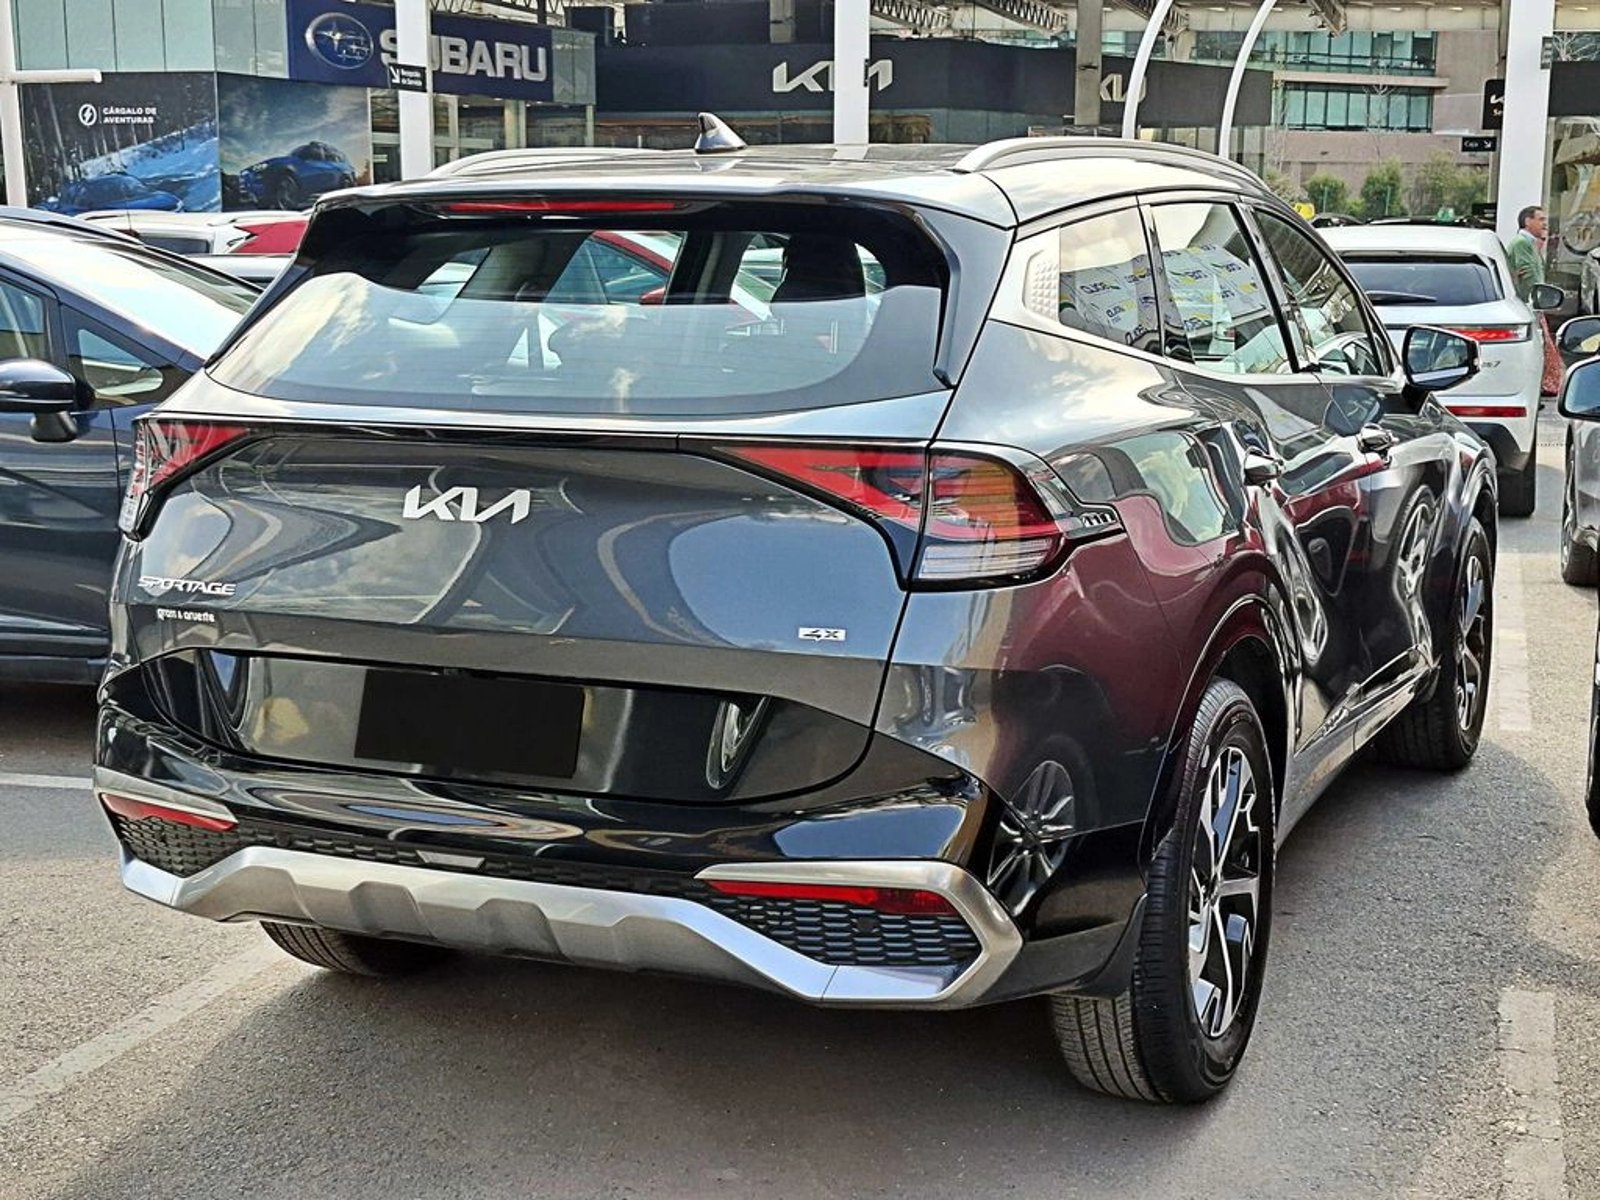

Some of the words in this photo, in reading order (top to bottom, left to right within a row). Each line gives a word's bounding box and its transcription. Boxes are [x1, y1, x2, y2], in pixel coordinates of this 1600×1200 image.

[102, 105, 143, 115] CÁRGALO
[144, 107, 157, 115] DE
[103, 116, 154, 124] AVENTURAS
[402, 484, 530, 524] KIA
[137, 575, 237, 596] SPORTAGE
